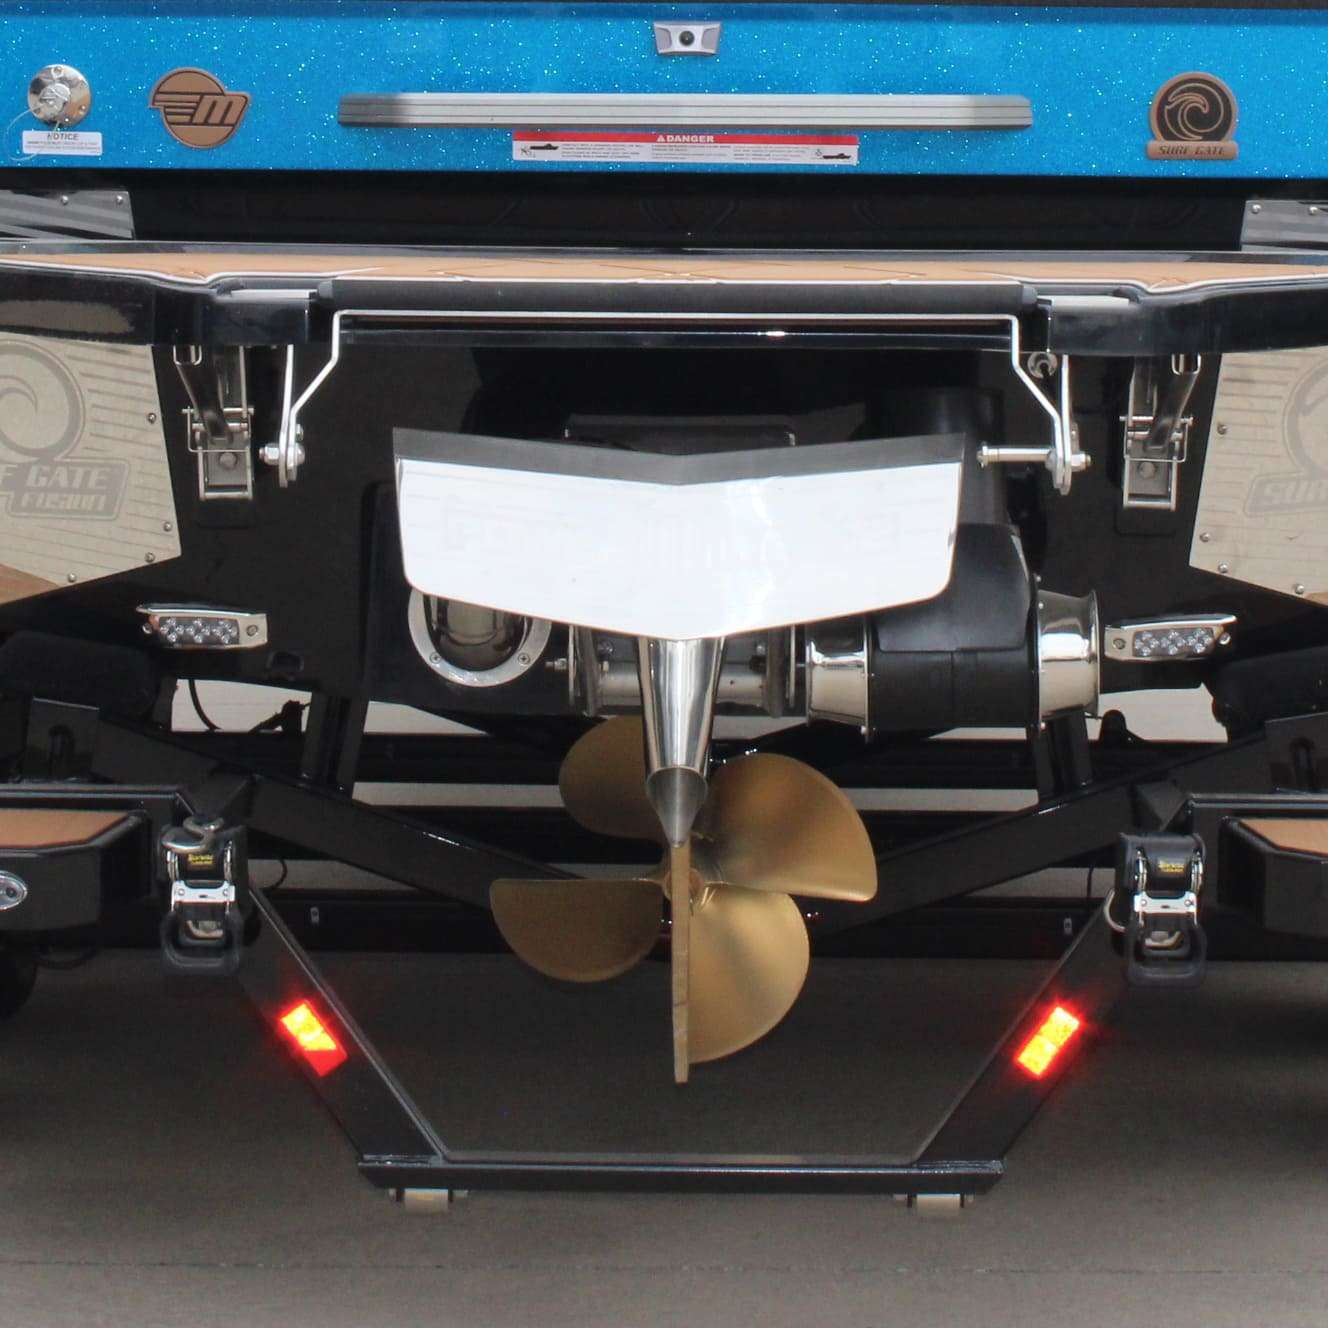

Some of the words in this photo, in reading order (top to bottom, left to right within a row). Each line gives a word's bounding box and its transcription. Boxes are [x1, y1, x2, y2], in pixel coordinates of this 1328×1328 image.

[47, 133, 80, 141] NOTICE
[666, 134, 715, 144] DANGER
[1158, 145, 1189, 155] SURF
[1194, 146, 1225, 155] GATE
[25, 465, 110, 490] GATE
